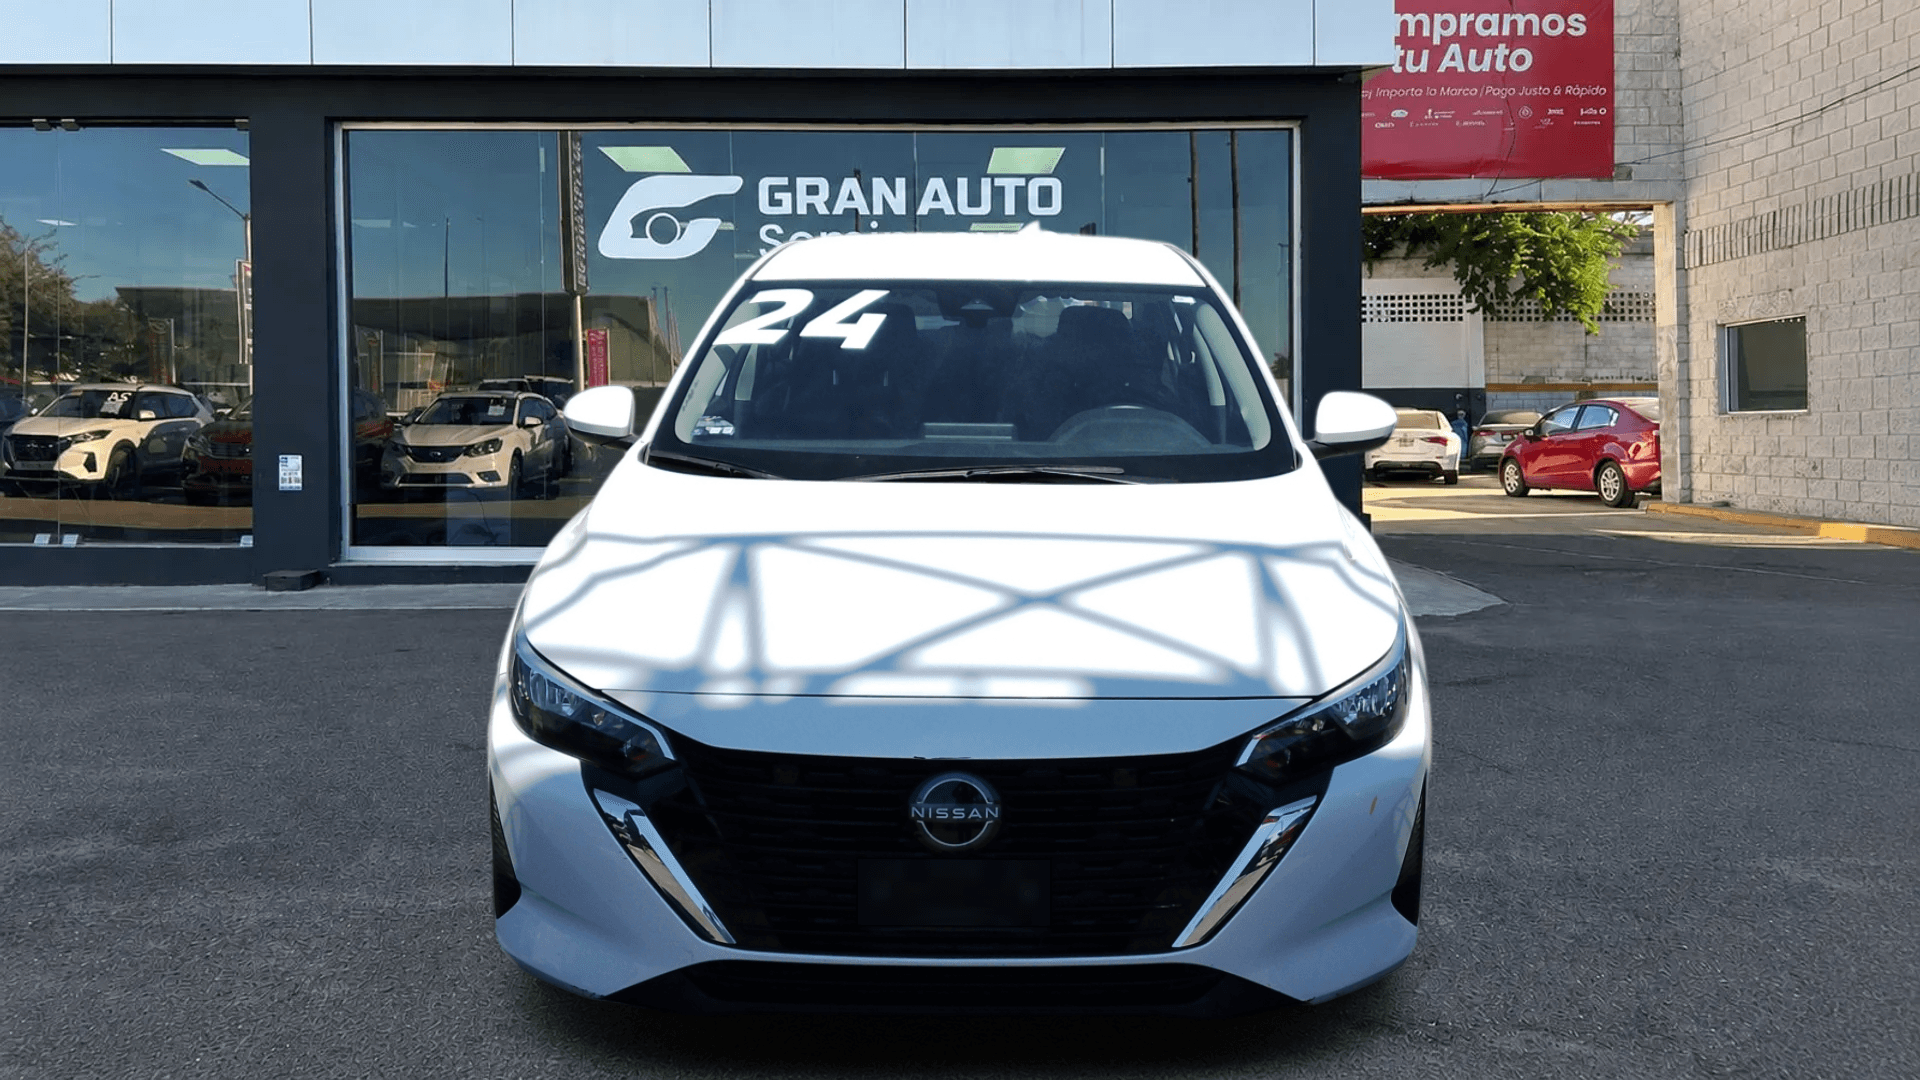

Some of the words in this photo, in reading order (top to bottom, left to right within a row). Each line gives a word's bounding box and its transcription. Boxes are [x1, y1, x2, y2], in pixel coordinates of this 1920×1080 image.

[1392, 45, 1430, 73] tu
[1437, 43, 1534, 72] Auto
[1376, 87, 1423, 99] Importa
[1440, 86, 1478, 96] Marca
[1519, 86, 1551, 96] Justo
[1553, 86, 1561, 96] &
[759, 177, 906, 215] GRAN
[917, 177, 1062, 215] AUTO
[712, 289, 889, 349] 24
[911, 807, 999, 819] NISSAN
